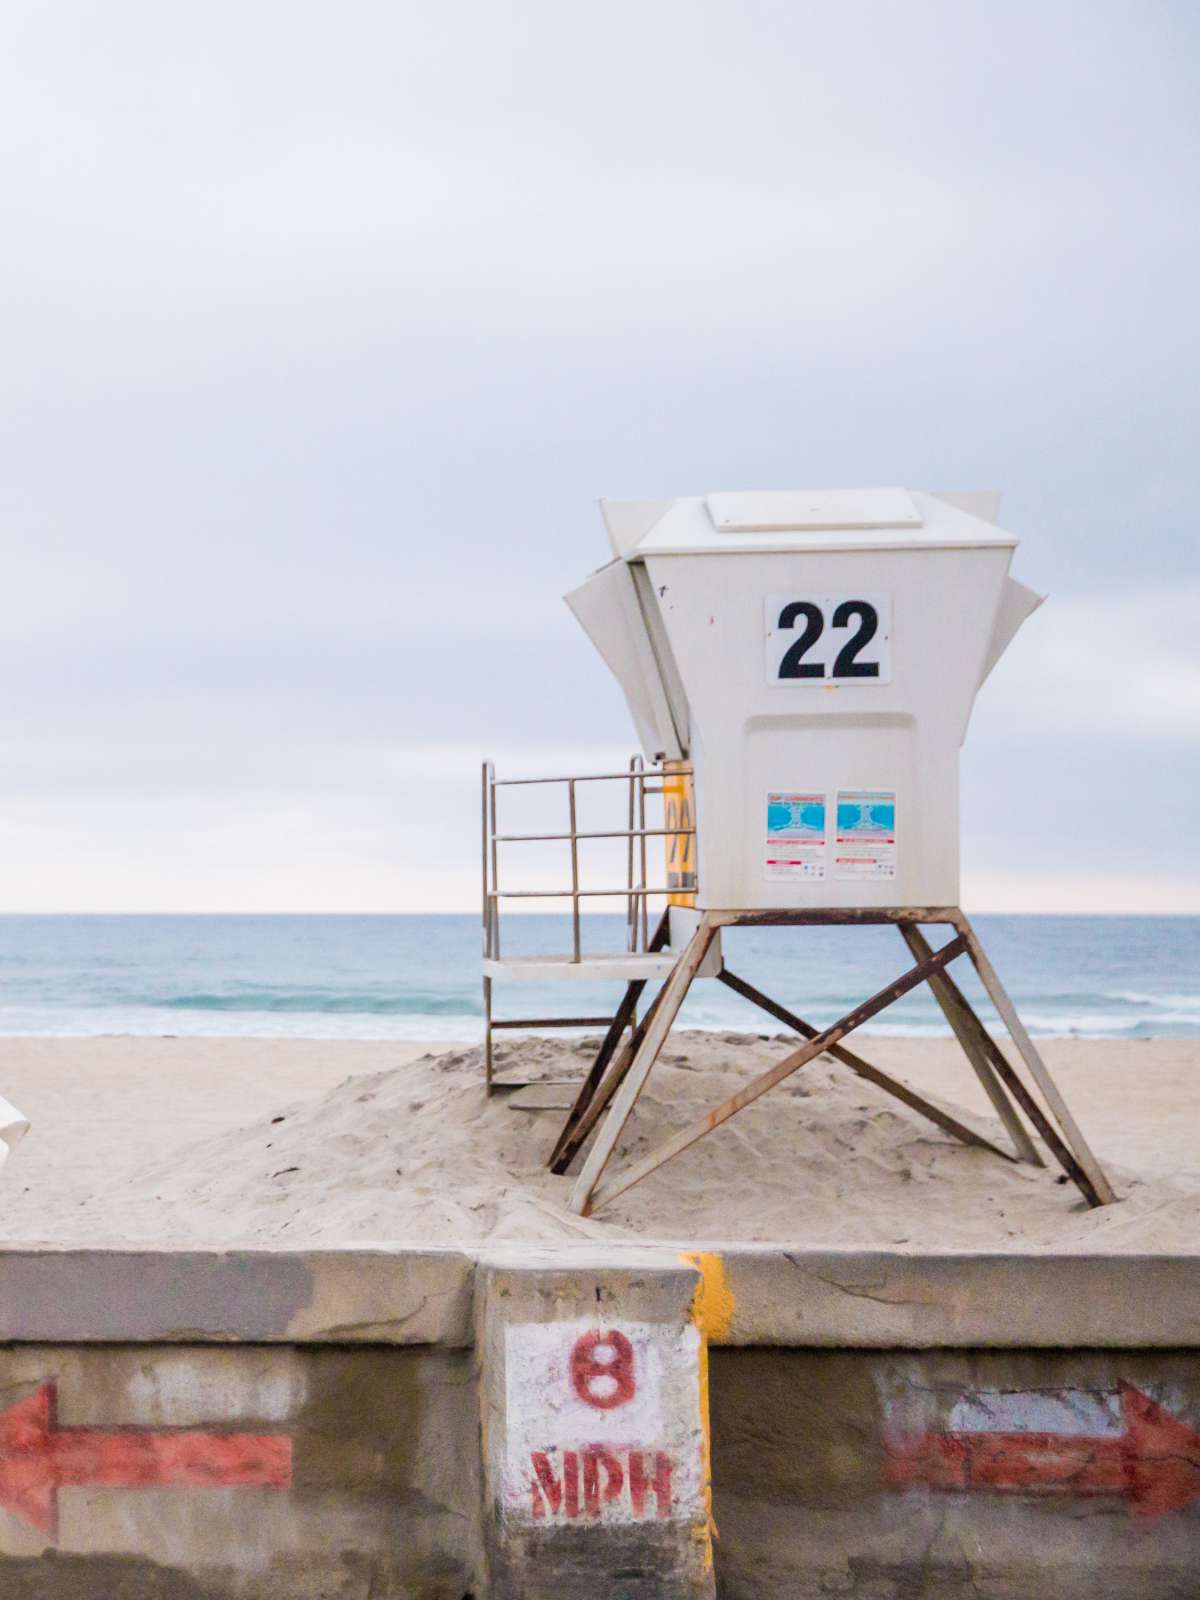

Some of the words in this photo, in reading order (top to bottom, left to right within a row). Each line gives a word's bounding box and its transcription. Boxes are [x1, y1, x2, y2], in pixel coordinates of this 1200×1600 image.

[777, 600, 880, 679] 22
[570, 1329, 636, 1410] 8
[530, 1450, 674, 1520] MPH
